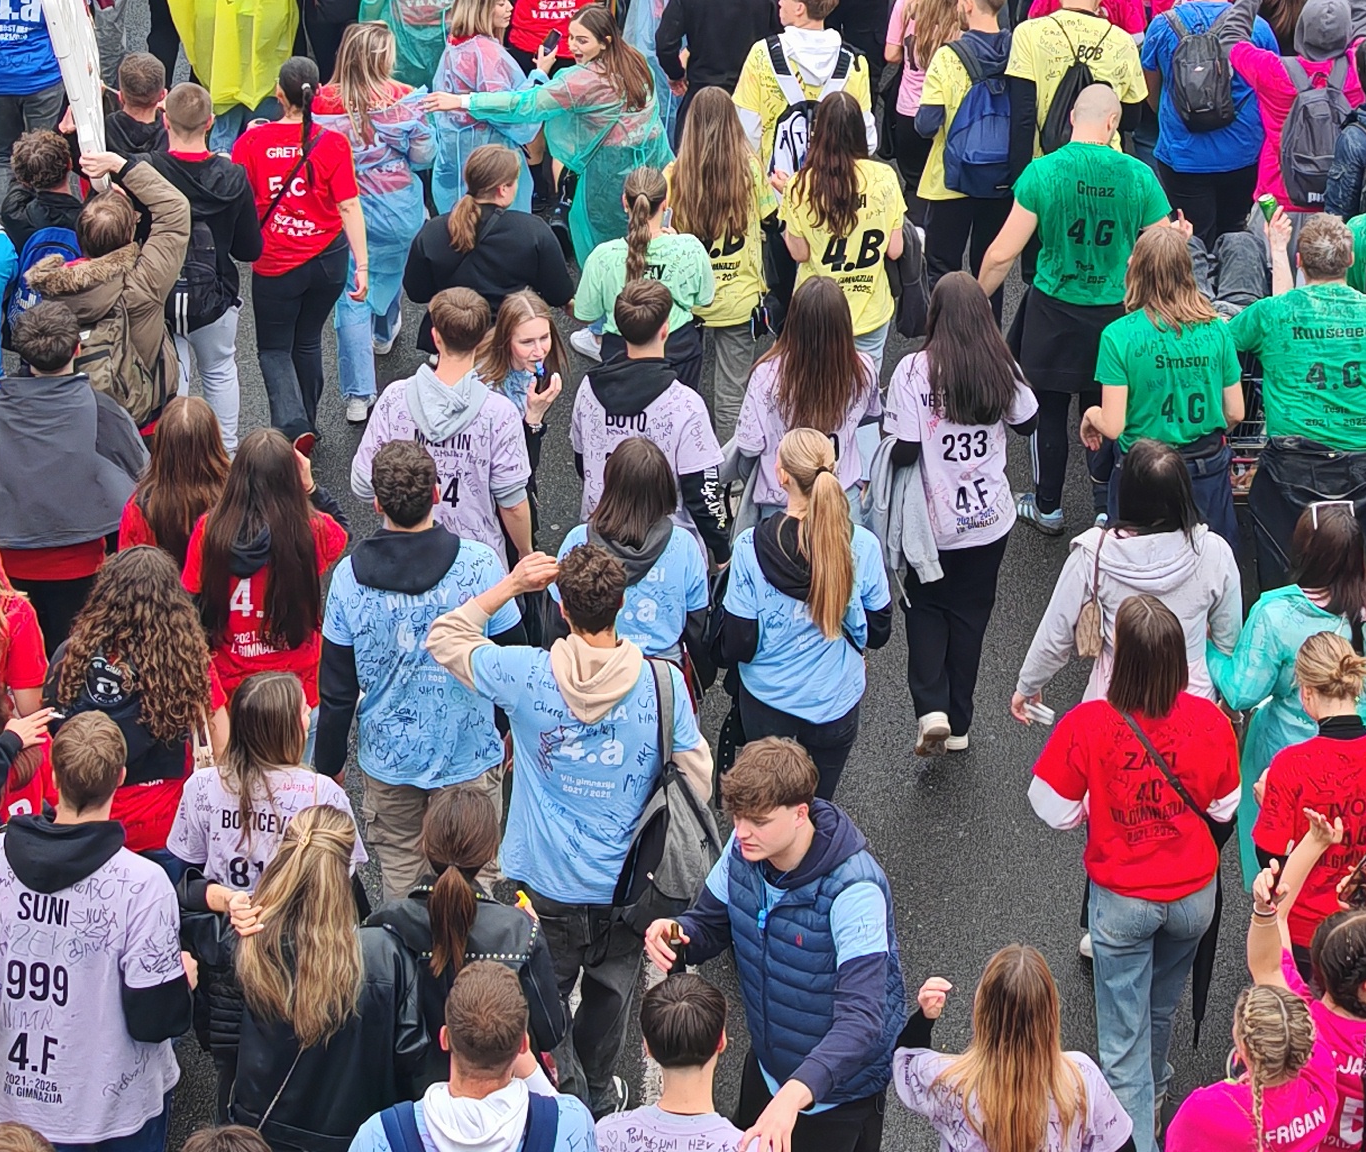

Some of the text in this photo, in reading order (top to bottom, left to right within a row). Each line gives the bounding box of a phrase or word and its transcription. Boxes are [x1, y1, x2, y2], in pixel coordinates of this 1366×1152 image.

[1078, 45, 1104, 61] BOB
[266, 146, 304, 159] GRETA
[1077, 180, 1115, 199] Gmaz
[1068, 219, 1116, 246] 4.G
[822, 229, 885, 272] 4.B
[1154, 354, 1209, 370] Samson
[1162, 391, 1206, 424] 4.G
[941, 428, 990, 462] 233
[954, 483, 989, 518] 4.F
[386, 587, 453, 611] MILKY
[575, 777, 616, 789] gimnazija
[18, 892, 69, 928] SUNI
[6, 960, 70, 1006] 999
[8, 1033, 58, 1074] 4.F
[17, 1087, 63, 1104] GIMNAZIJA
